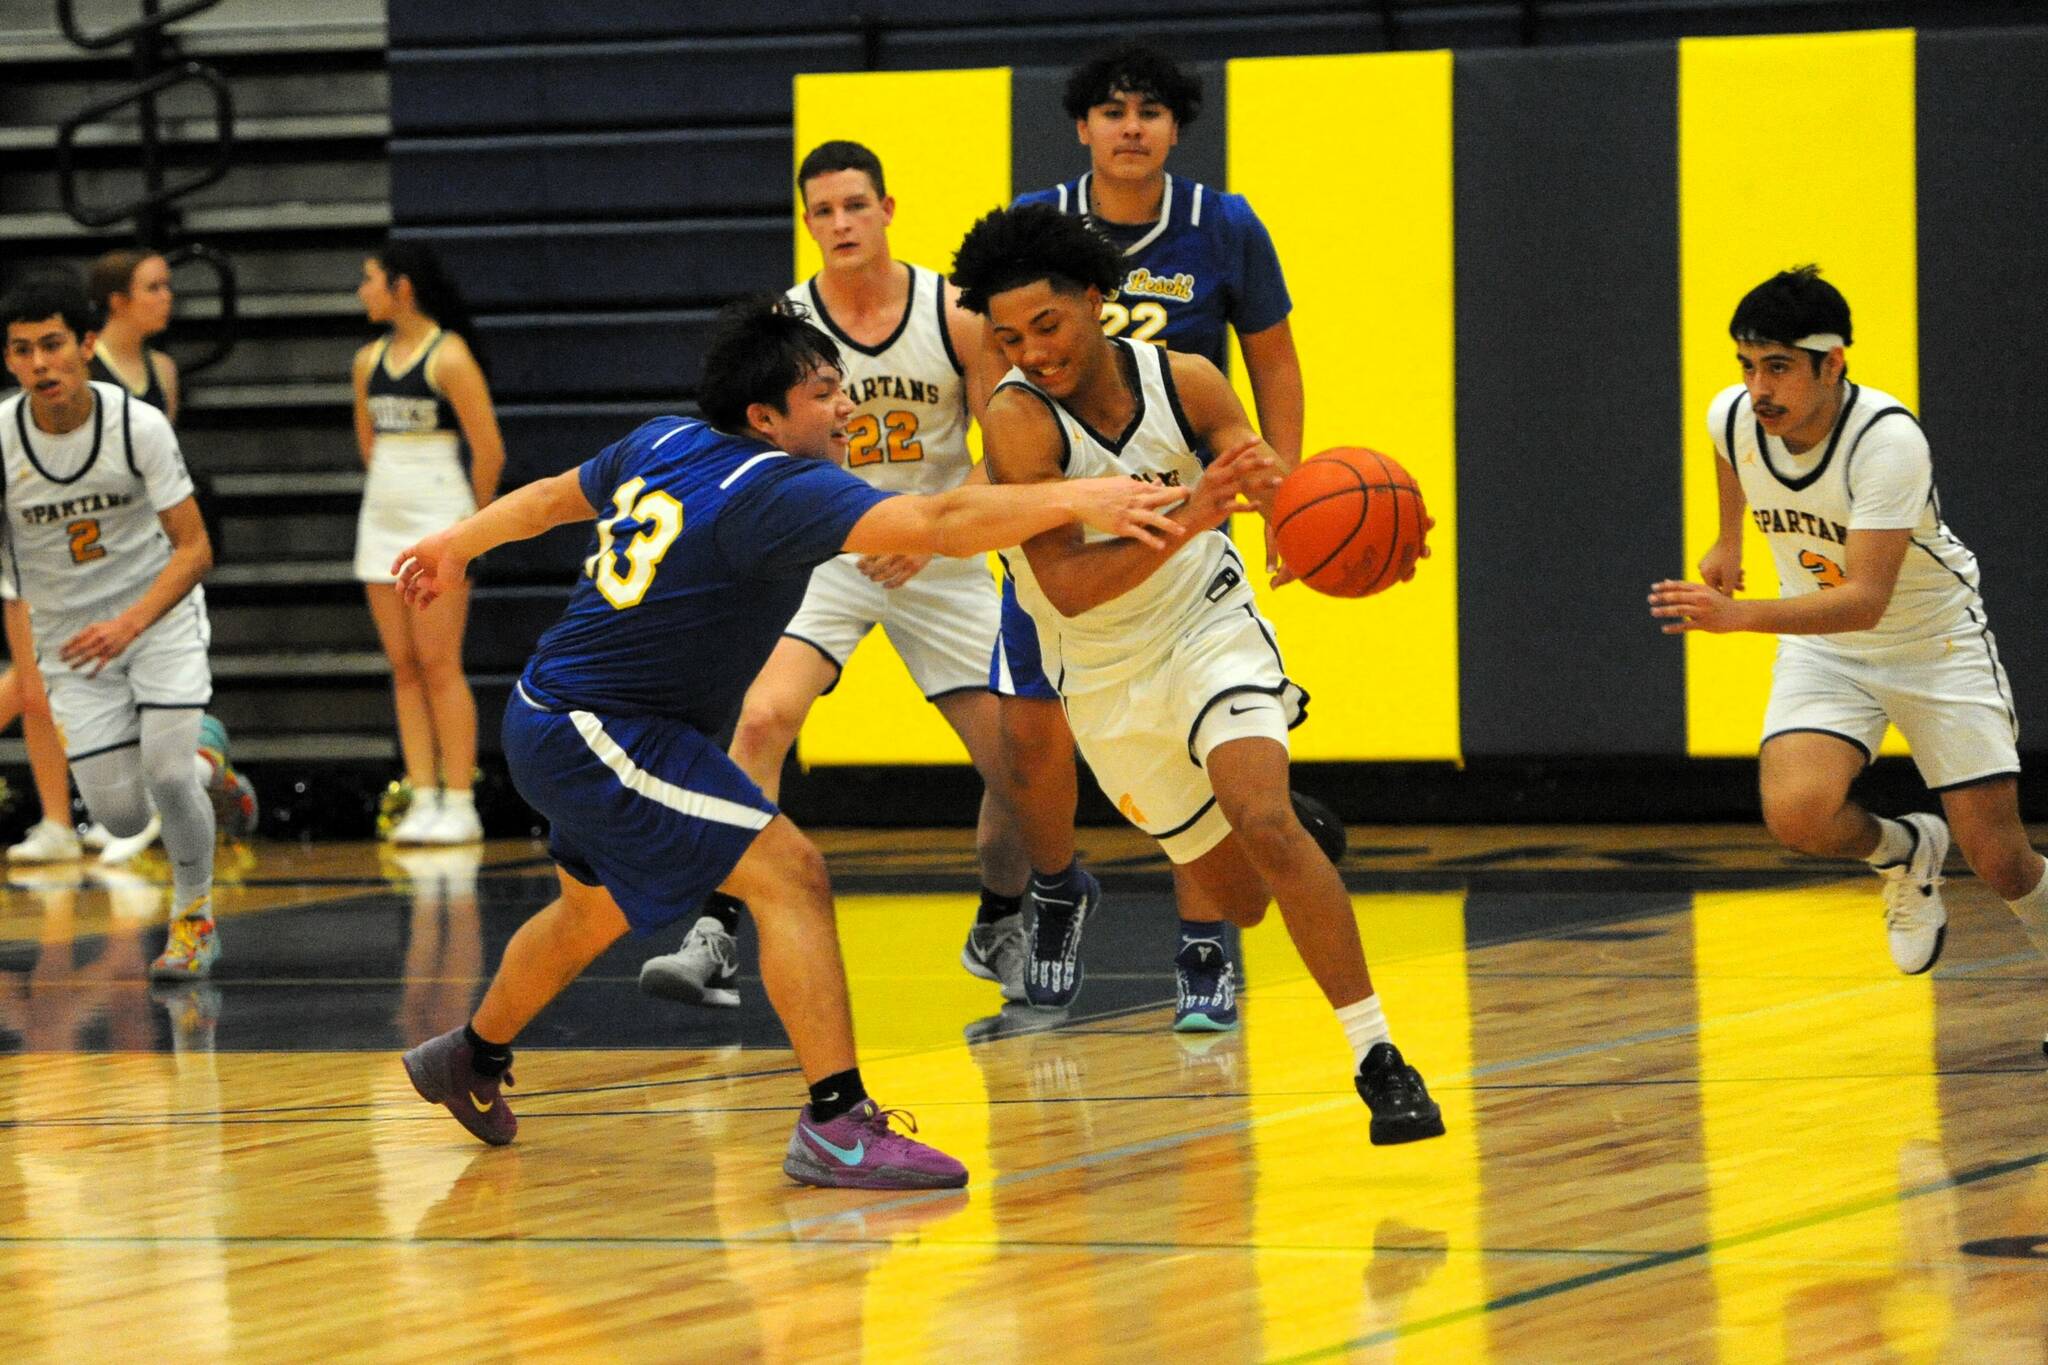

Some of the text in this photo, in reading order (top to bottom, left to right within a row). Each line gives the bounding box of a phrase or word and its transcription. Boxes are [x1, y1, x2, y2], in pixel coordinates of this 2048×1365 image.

[1100, 301, 1167, 348] 22
[843, 375, 939, 405] ARTANS
[846, 410, 924, 468] 22
[66, 518, 107, 565] 2
[584, 476, 683, 611] 13
